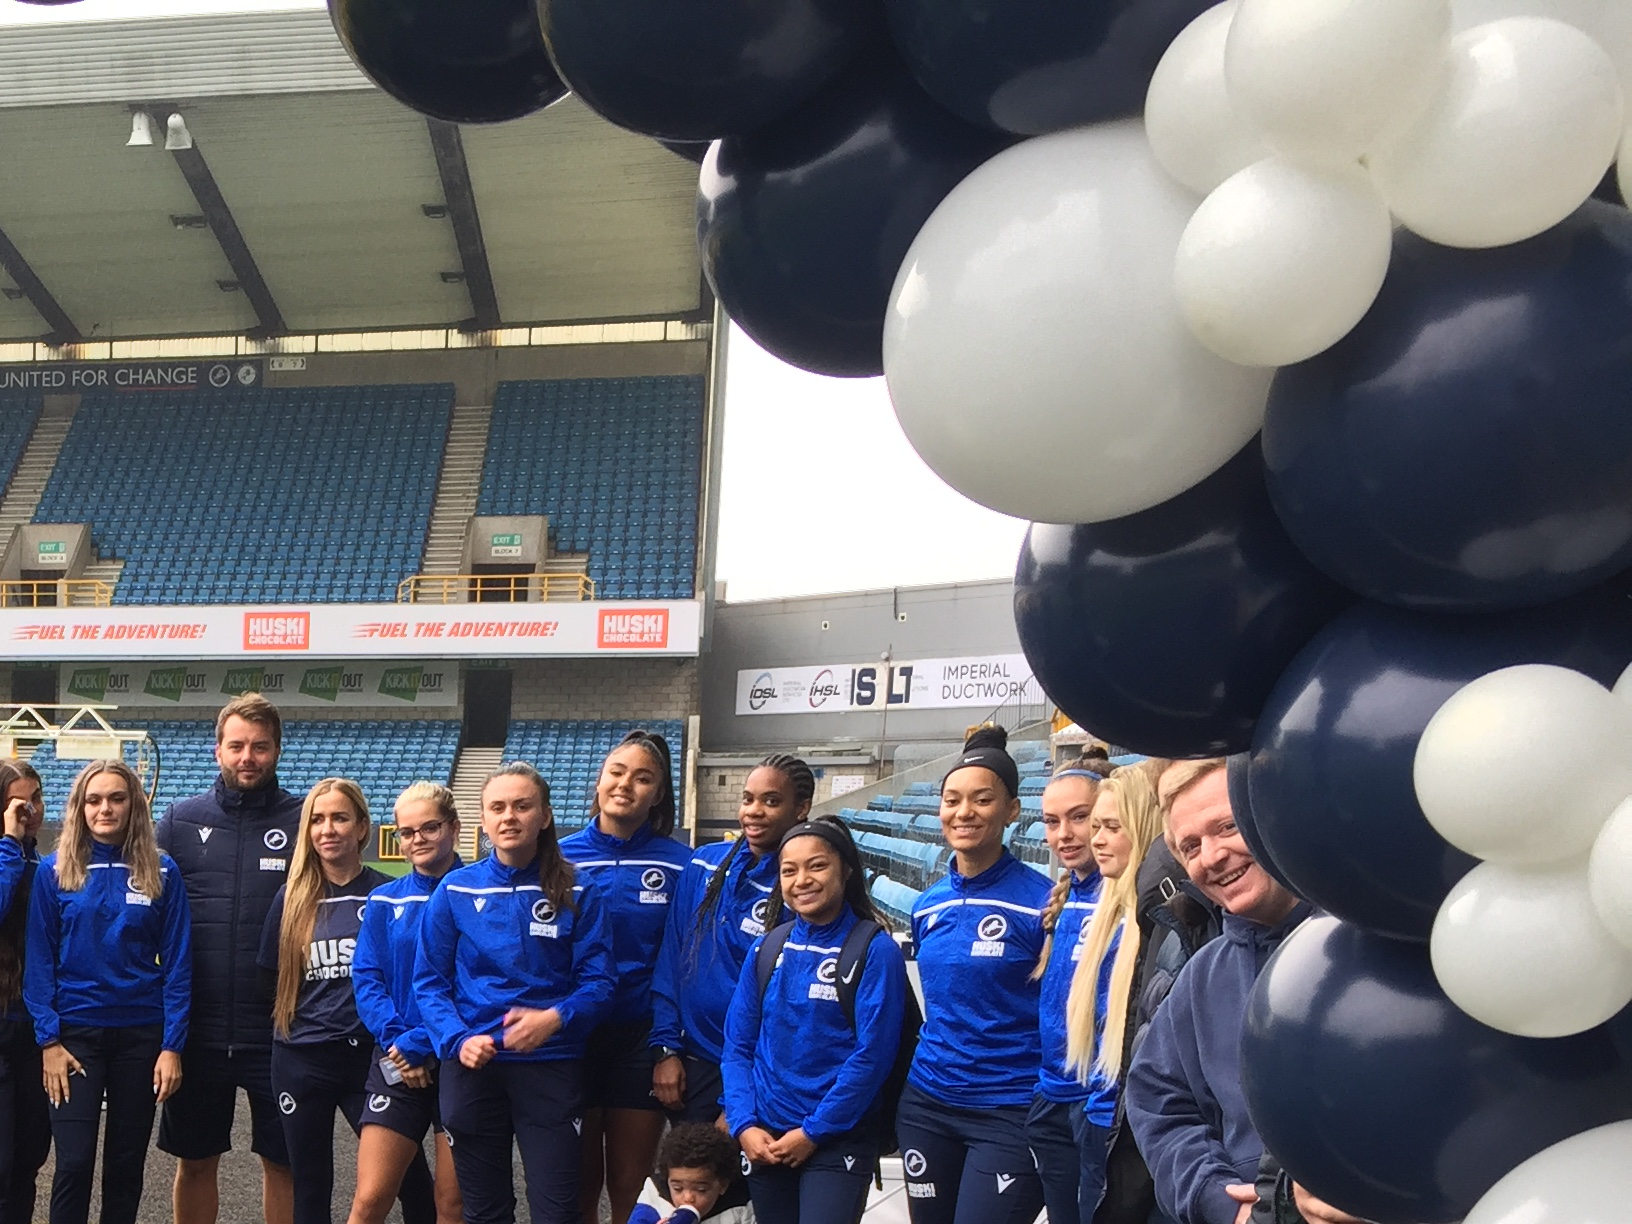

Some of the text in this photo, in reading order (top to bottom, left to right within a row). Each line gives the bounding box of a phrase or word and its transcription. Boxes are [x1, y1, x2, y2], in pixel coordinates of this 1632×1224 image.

[71, 369, 109, 387] FOR
[115, 367, 198, 386] CHANGE
[40, 543, 56, 551] EXIT
[493, 536, 511, 545] EXIT
[249, 617, 305, 635] HUSKI
[360, 621, 559, 638] FUEL THE ADVENTURE!
[603, 614, 663, 634] HUSKI
[20, 624, 208, 640] FUEL THE ADVENTURE!
[603, 634, 663, 643] CHOCOLATE
[248, 635, 305, 645] CHOCOLATE
[942, 663, 1011, 681] IMPERIAL
[75, 674, 98, 689] KICK
[109, 674, 130, 688] OUT
[151, 674, 174, 689] KICK
[185, 674, 207, 688] OUT
[228, 674, 251, 688] KICK
[263, 673, 284, 688] OUT
[306, 673, 331, 688] KICK
[342, 673, 363, 688] OUT
[385, 673, 409, 688] KICK
[421, 673, 444, 688] OUT
[942, 681, 1027, 700] DUCTWORK
